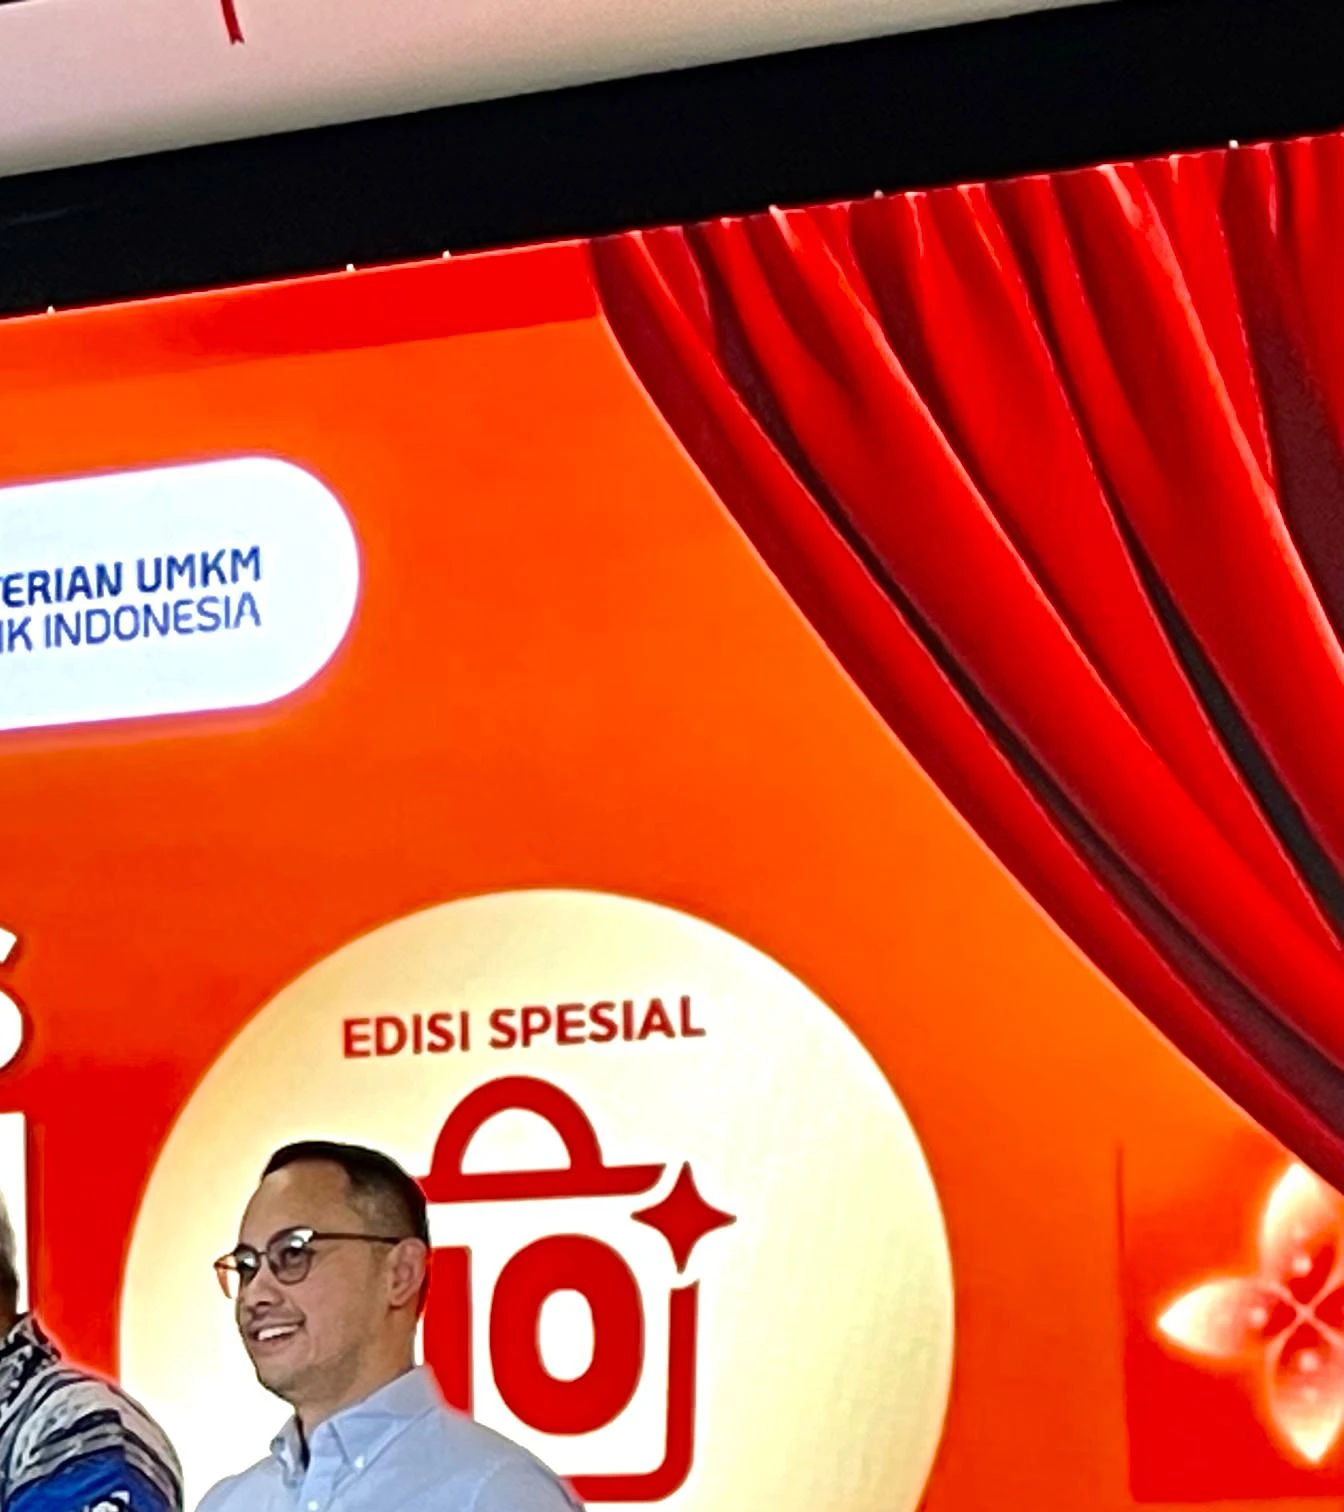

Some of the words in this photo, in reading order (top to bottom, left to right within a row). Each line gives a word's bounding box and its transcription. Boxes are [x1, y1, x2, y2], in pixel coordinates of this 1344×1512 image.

[136, 546, 262, 593] UMKM
[44, 591, 262, 648] INDONESIA
[341, 1009, 471, 1060] EDISI
[488, 996, 706, 1052] SPESIAL
